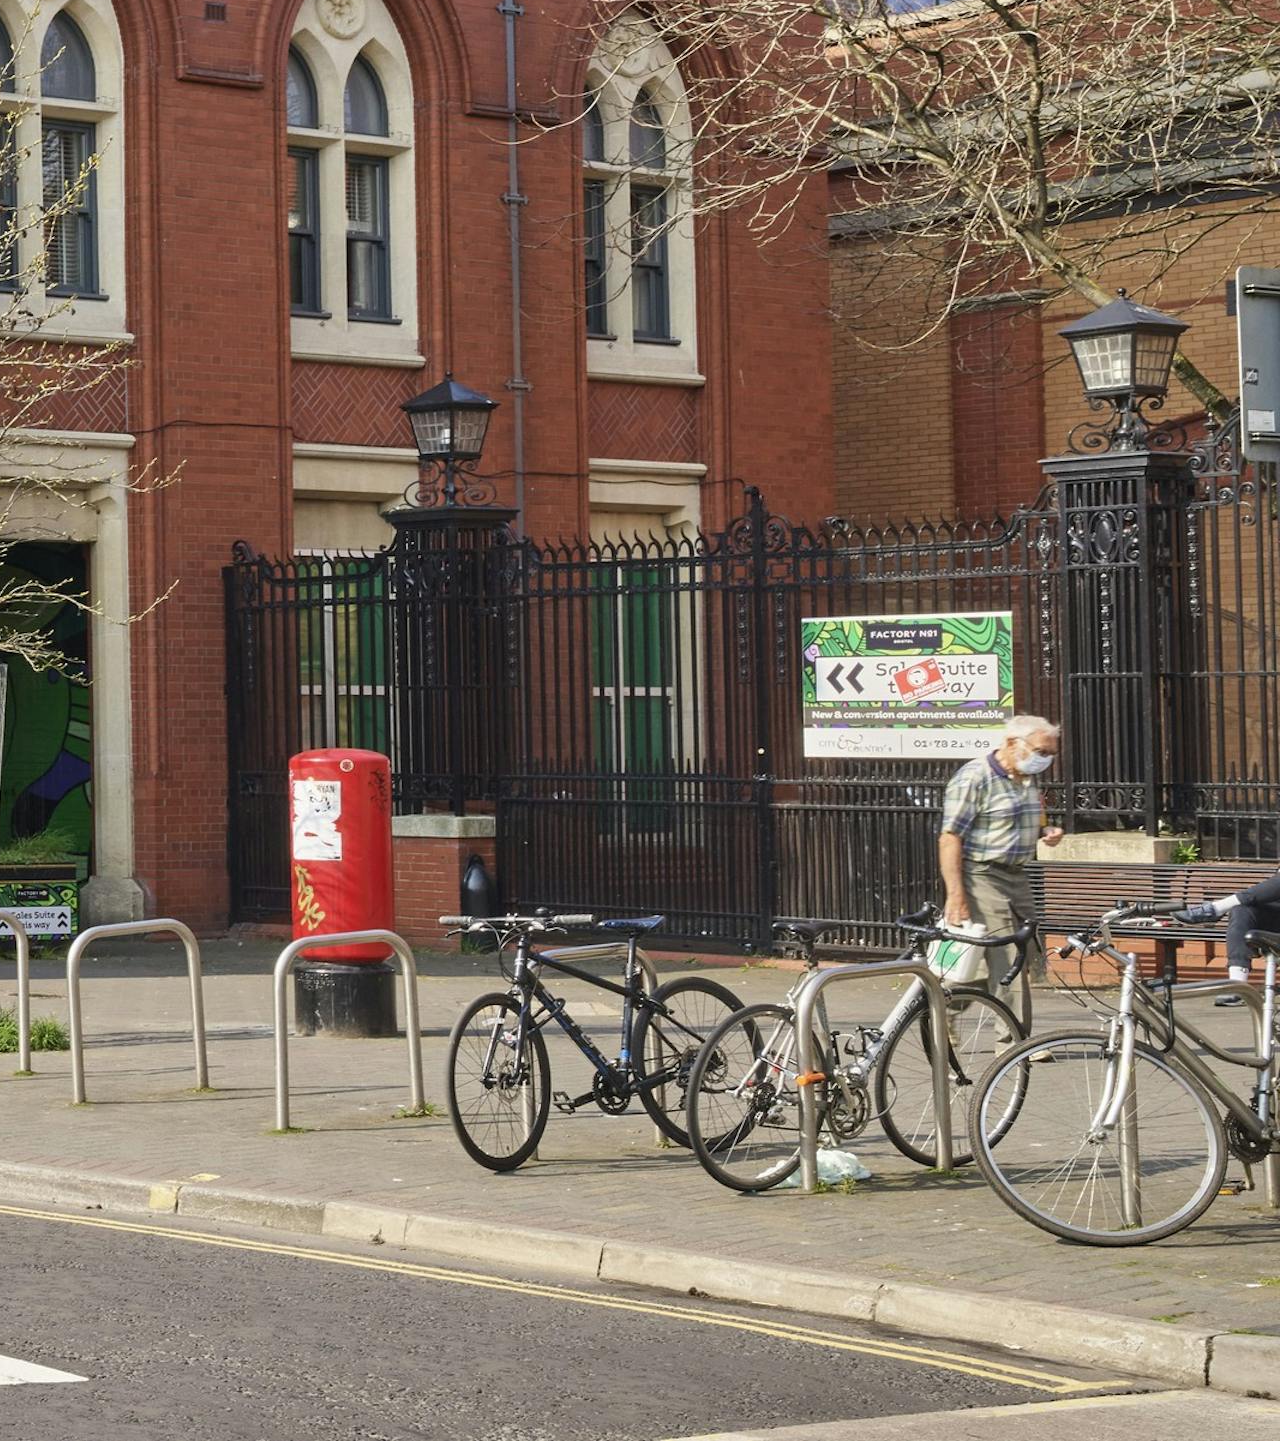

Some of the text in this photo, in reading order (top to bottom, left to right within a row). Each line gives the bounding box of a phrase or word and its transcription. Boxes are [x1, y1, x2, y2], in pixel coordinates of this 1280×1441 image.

[870, 630, 915, 639] FACTORY
[811, 710, 1005, 720] New & conversion apartments available
[34, 911, 56, 920] Suite
[34, 921, 51, 930] way
